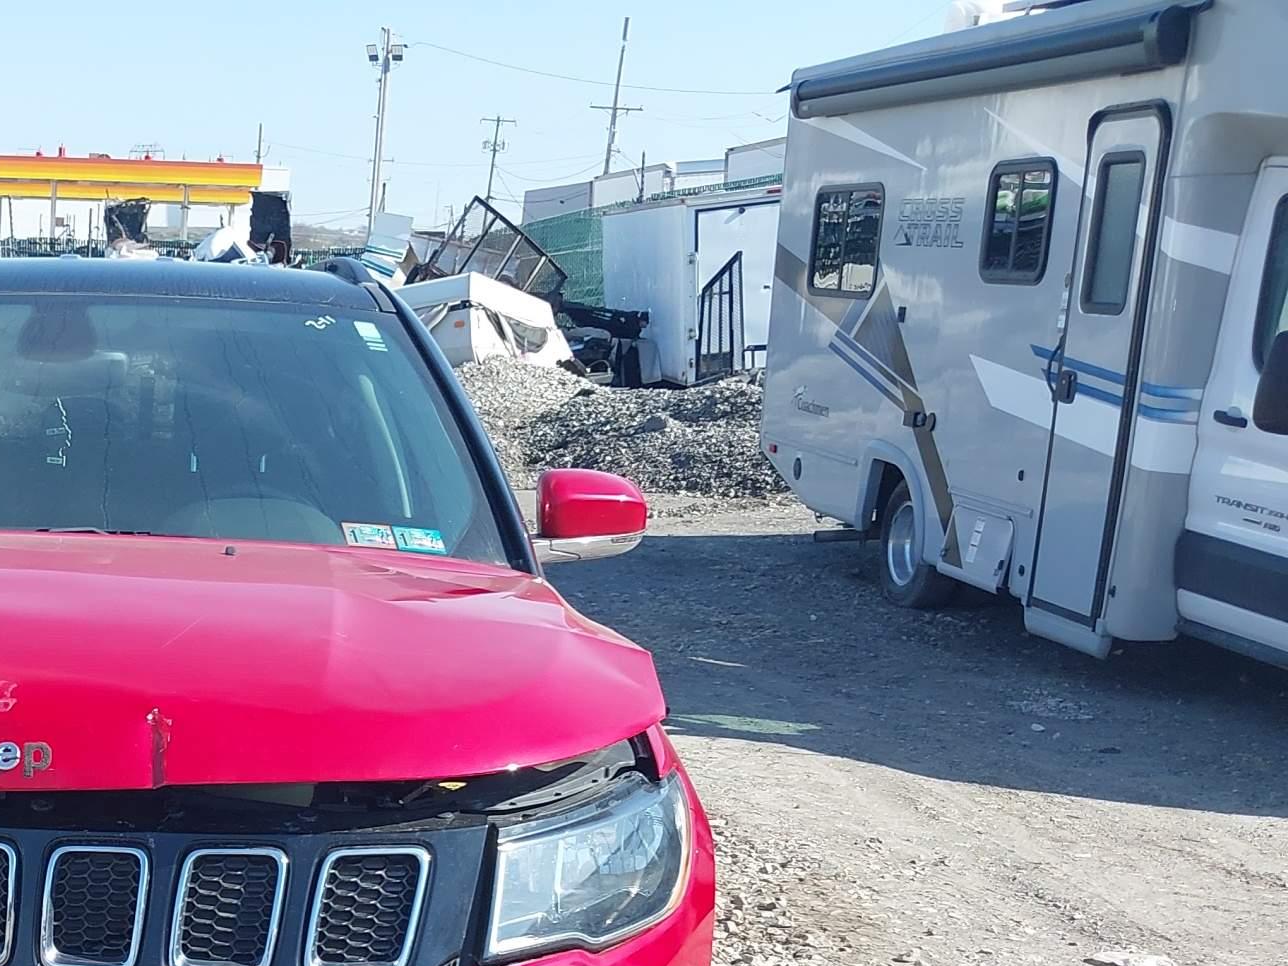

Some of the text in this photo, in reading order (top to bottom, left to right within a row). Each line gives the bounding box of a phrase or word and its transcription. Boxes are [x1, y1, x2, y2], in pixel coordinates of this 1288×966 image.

[898, 197, 965, 222] CROSS
[906, 222, 964, 248] TRAIL
[1215, 495, 1268, 514] TRANSIT
